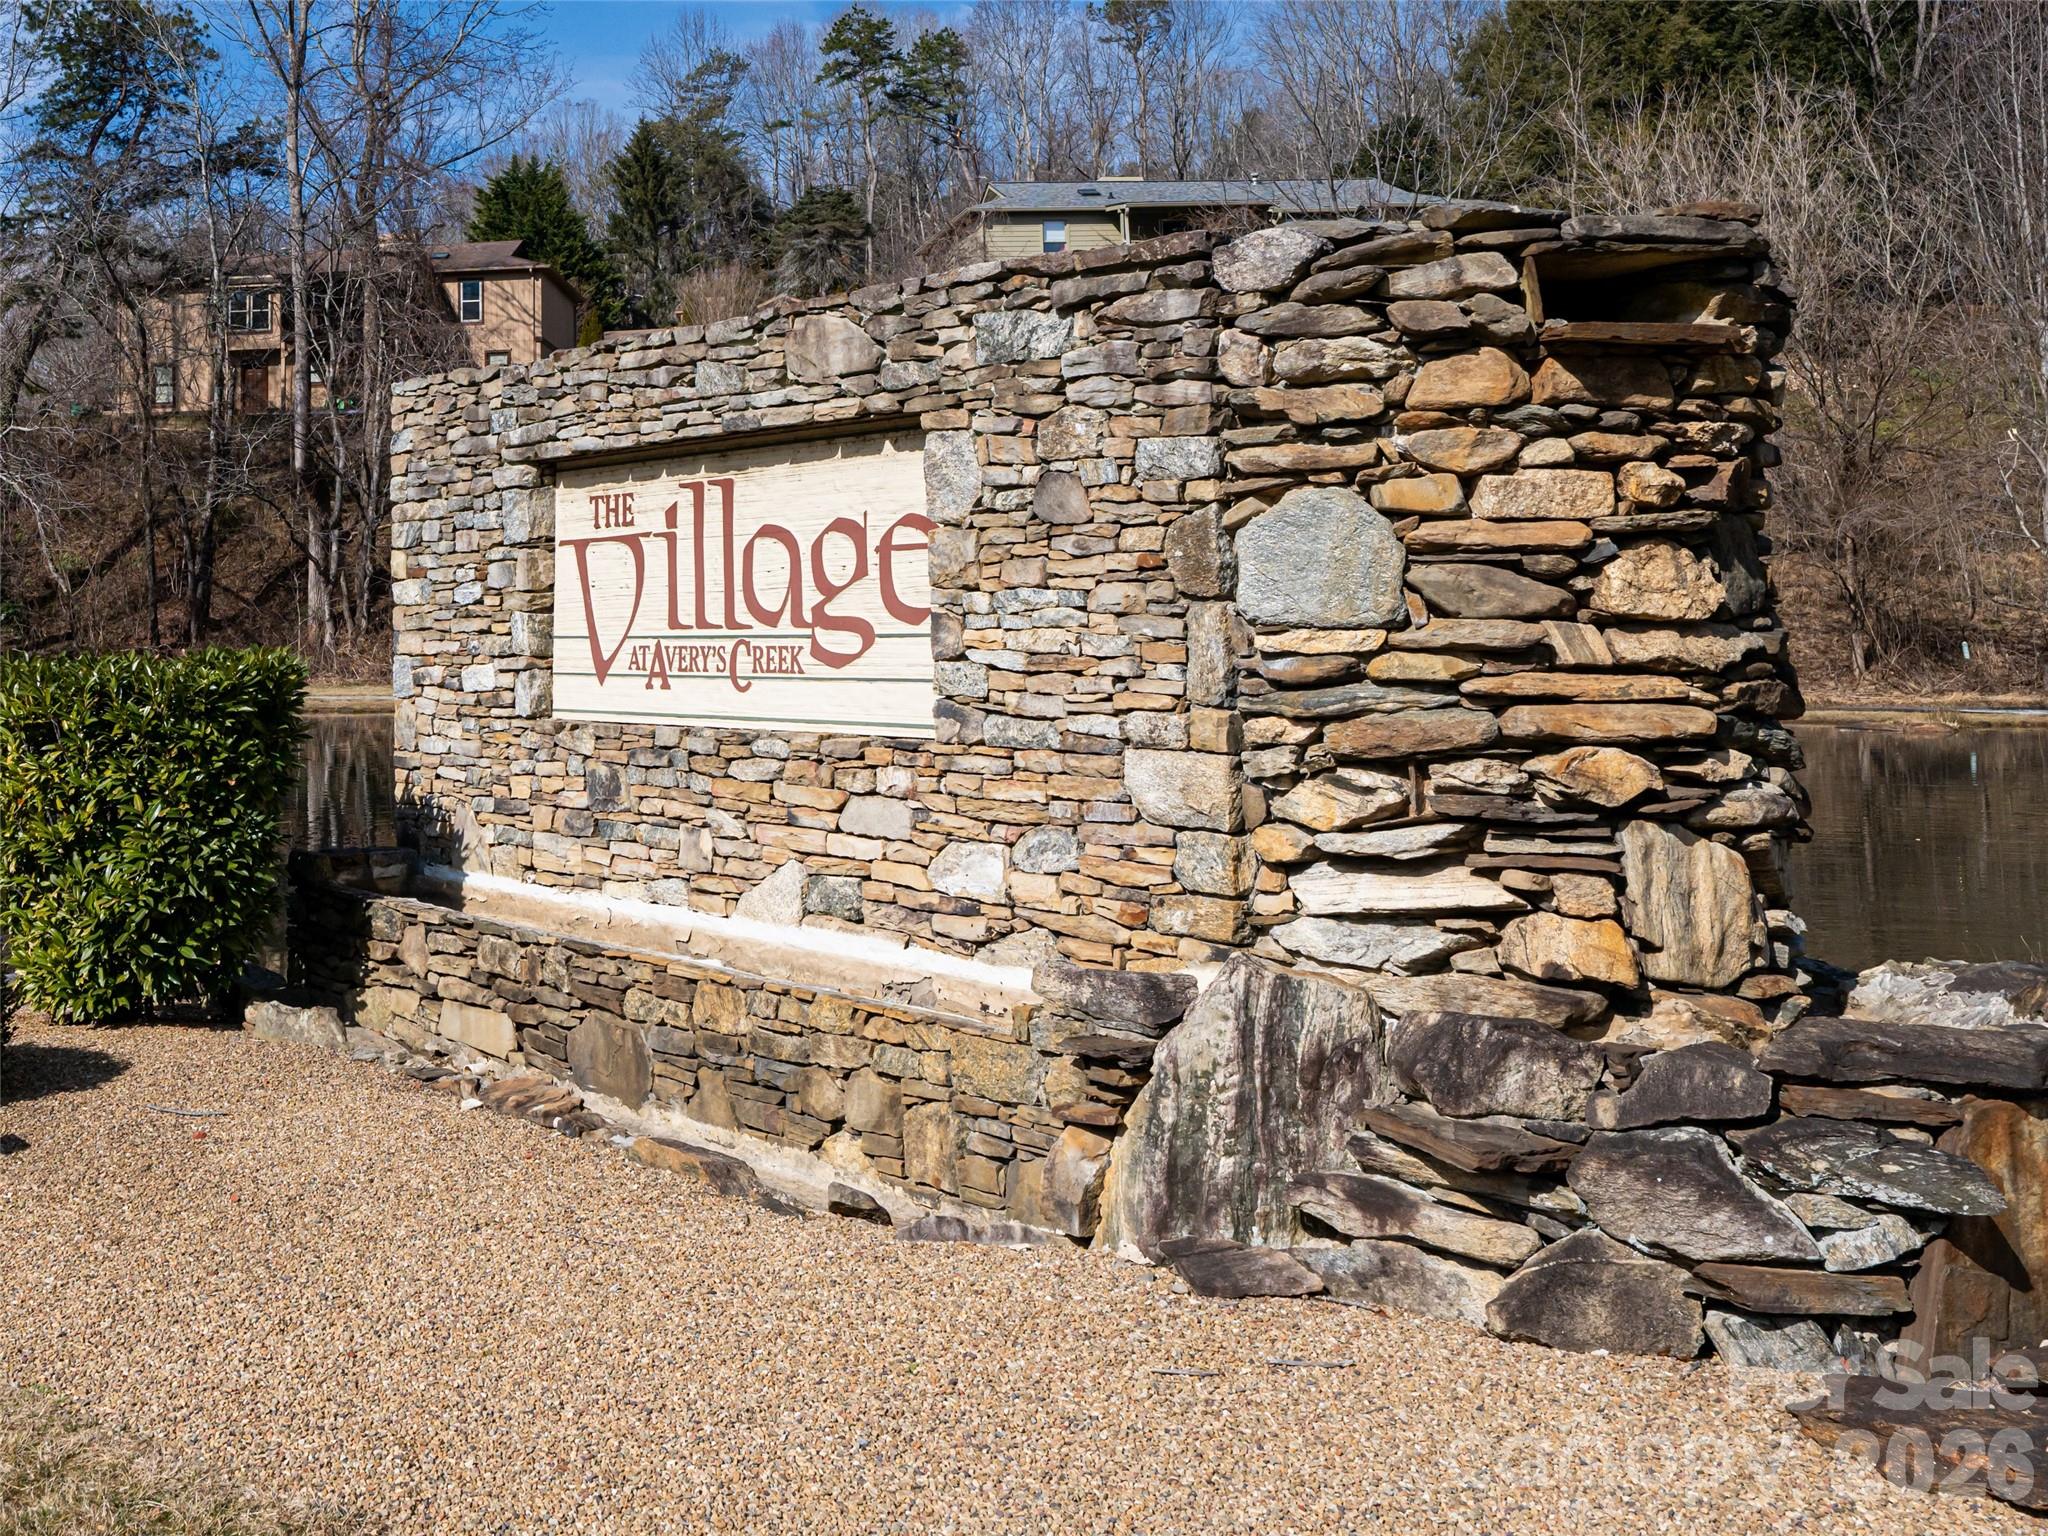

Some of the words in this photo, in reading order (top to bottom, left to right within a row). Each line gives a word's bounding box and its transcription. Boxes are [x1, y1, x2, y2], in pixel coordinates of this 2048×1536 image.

[589, 492, 635, 529] THE
[558, 477, 940, 687] Village
[628, 645, 650, 671] AT
[645, 639, 727, 690] AVERY'S
[729, 638, 805, 693] CREEK
